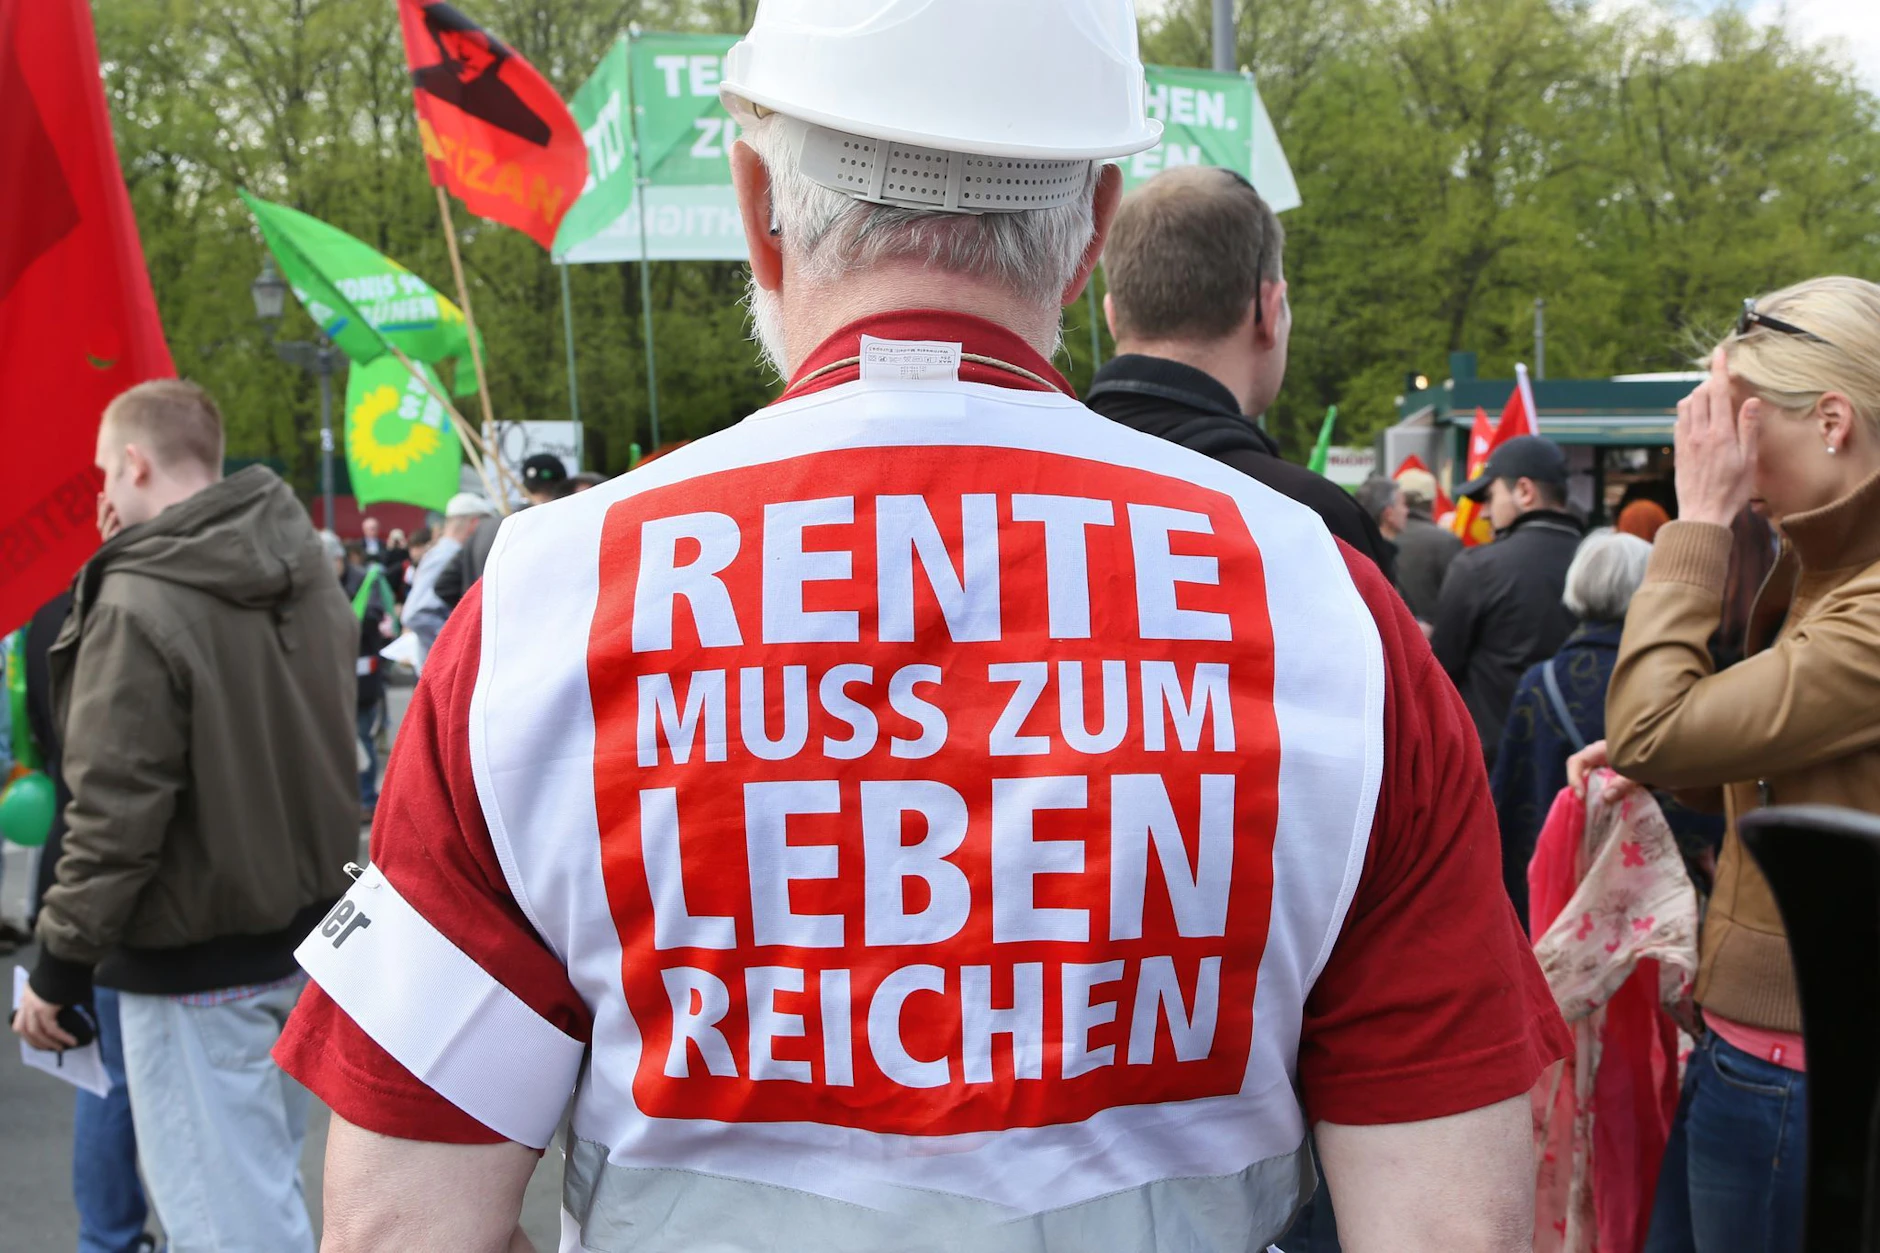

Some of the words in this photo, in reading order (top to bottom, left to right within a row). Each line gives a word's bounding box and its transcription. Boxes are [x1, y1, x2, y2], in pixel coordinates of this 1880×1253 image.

[653, 55, 728, 98] TE
[631, 493, 1233, 653] RENTE
[636, 663, 949, 768] MUSS
[987, 659, 1236, 757] ZUM
[318, 893, 372, 949] er
[639, 773, 1235, 950] LEBEN
[660, 956, 1223, 1088] REICHEN
